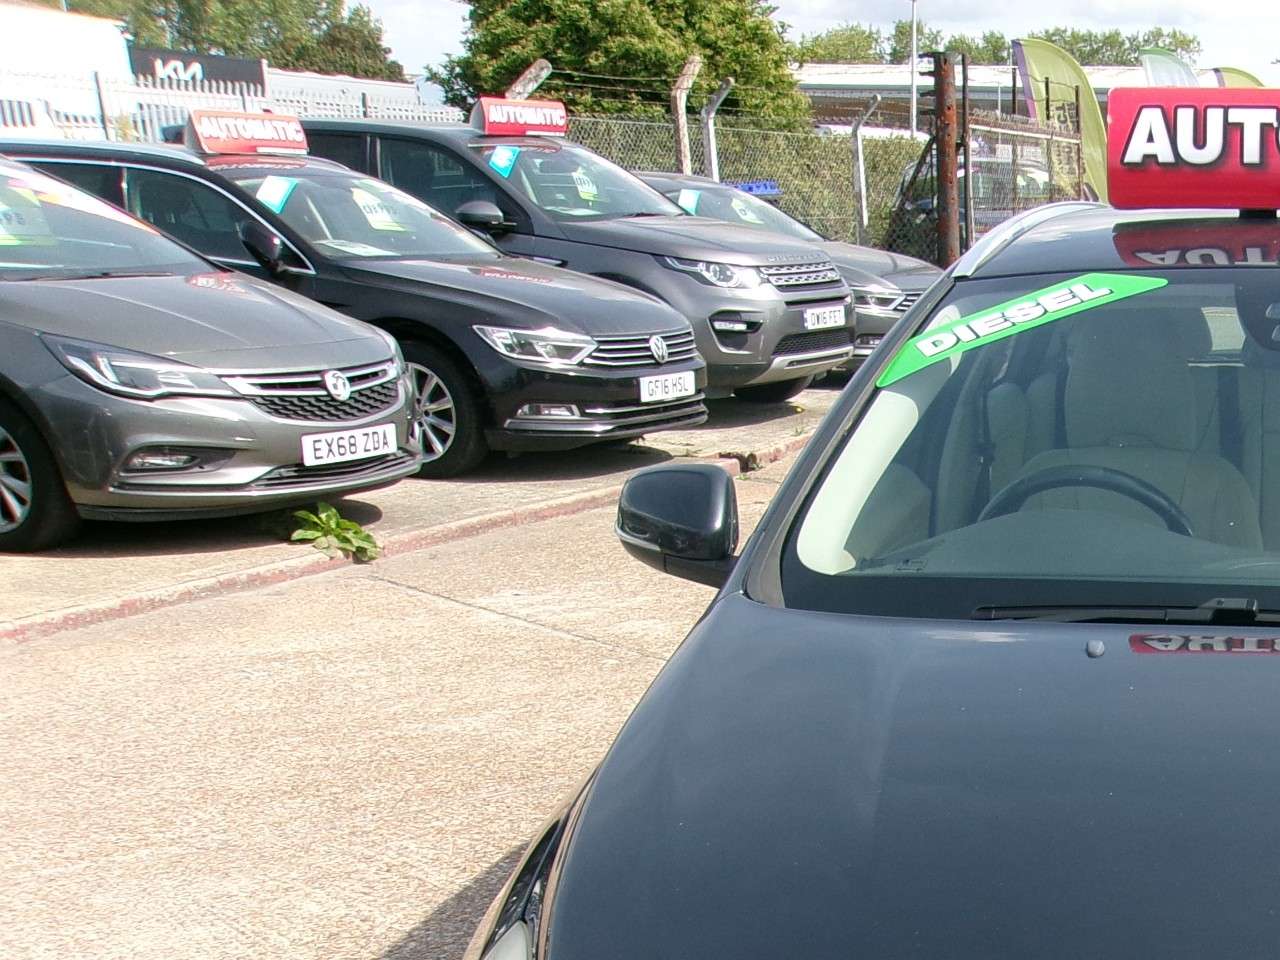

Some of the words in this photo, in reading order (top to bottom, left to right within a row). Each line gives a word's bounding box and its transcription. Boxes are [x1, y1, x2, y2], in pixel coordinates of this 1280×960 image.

[488, 104, 566, 127] AUTOMATIC
[200, 116, 305, 143] AUTOMATIC
[914, 283, 1115, 357] DIESEL
[312, 435, 358, 460] EX68
